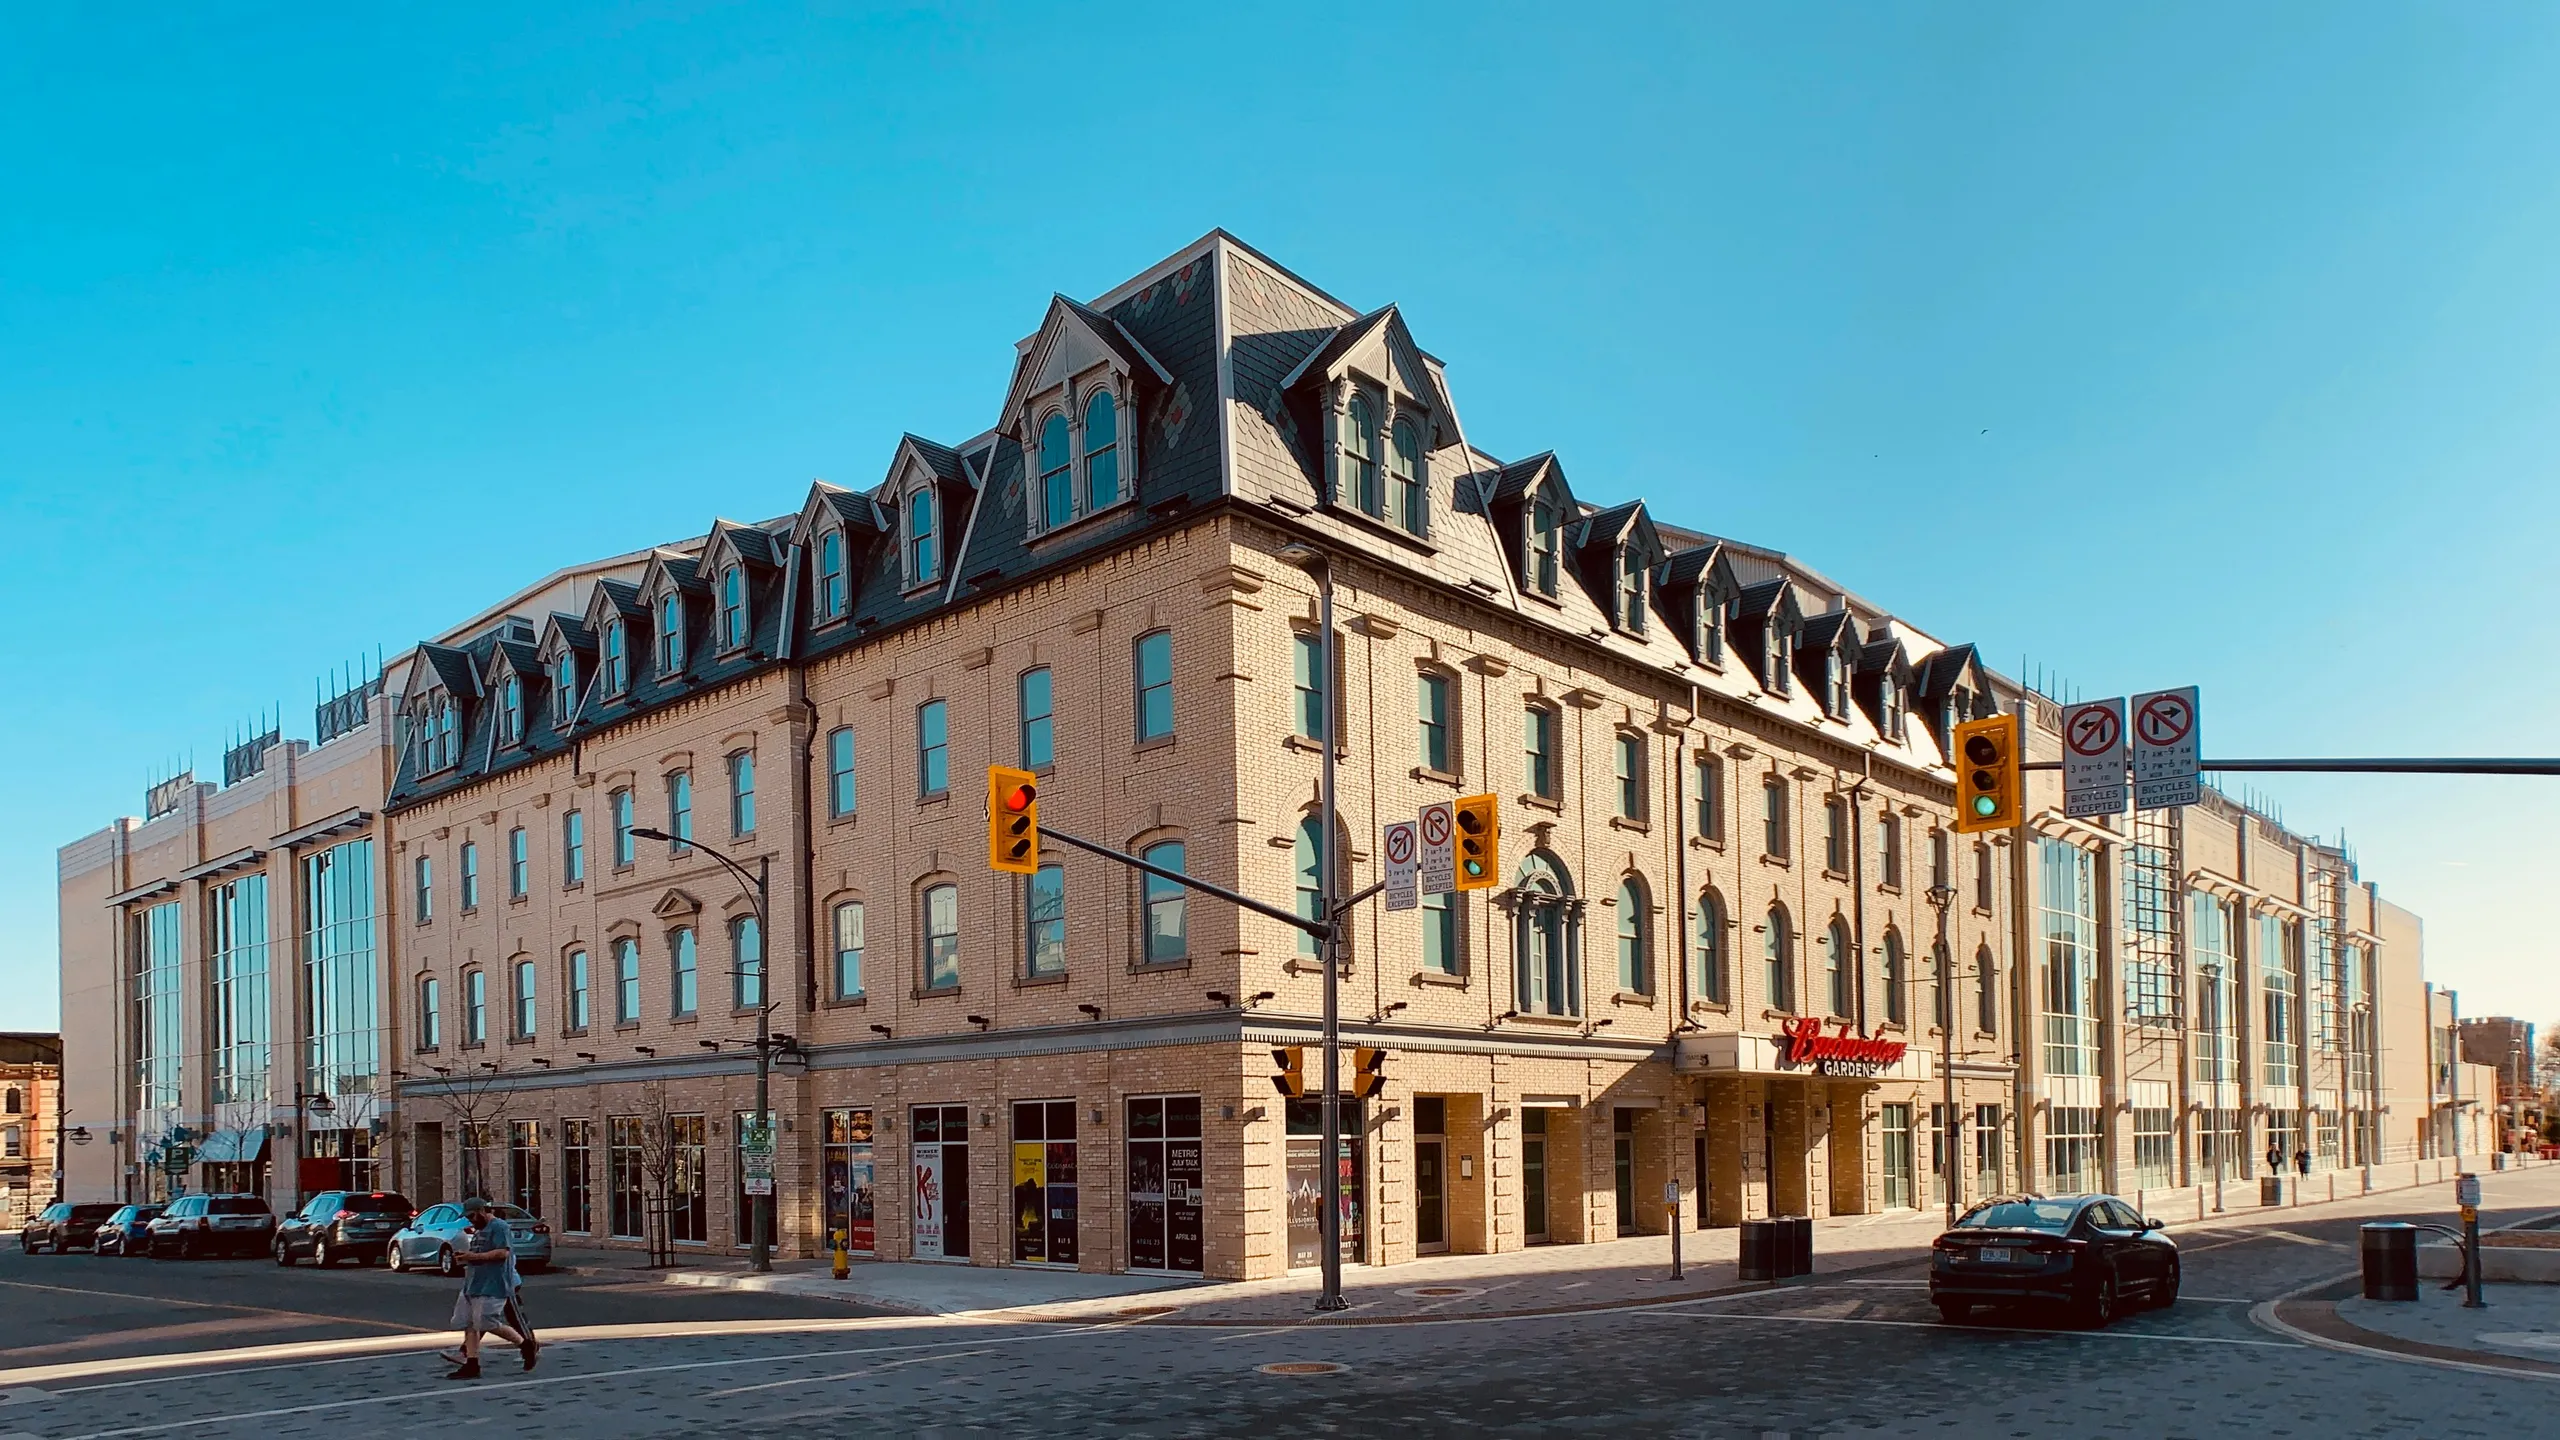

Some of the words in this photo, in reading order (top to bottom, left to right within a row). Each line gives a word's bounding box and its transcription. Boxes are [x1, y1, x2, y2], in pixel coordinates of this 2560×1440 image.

[2140, 750, 2147, 760] 7
[2180, 746, 2191, 754] AM
[2069, 764, 2077, 774] 3
[2108, 760, 2119, 768] PM
[2140, 761, 2148, 772] 3
[2180, 758, 2191, 767] PM
[2141, 780, 2192, 795] BICYCLES
[2071, 789, 2119, 803] BICYCLES
[2139, 791, 2195, 807] EXCEPTED
[2068, 801, 2122, 814] EXCEPTED
[1425, 873, 1452, 883] BICYCLES
[1425, 881, 1453, 892] EXCEPTED
[1388, 890, 1414, 900] BICYCLES
[1387, 898, 1415, 909] EXCEPTED
[1783, 1017, 1908, 1063] Budweiser
[1824, 1060, 1877, 1078] GARDENS
[171, 1149, 184, 1159] P
[1172, 1149, 1198, 1158] METRIC
[1136, 1238, 1153, 1246] APRIL
[1175, 1233, 1190, 1241] APRIL
